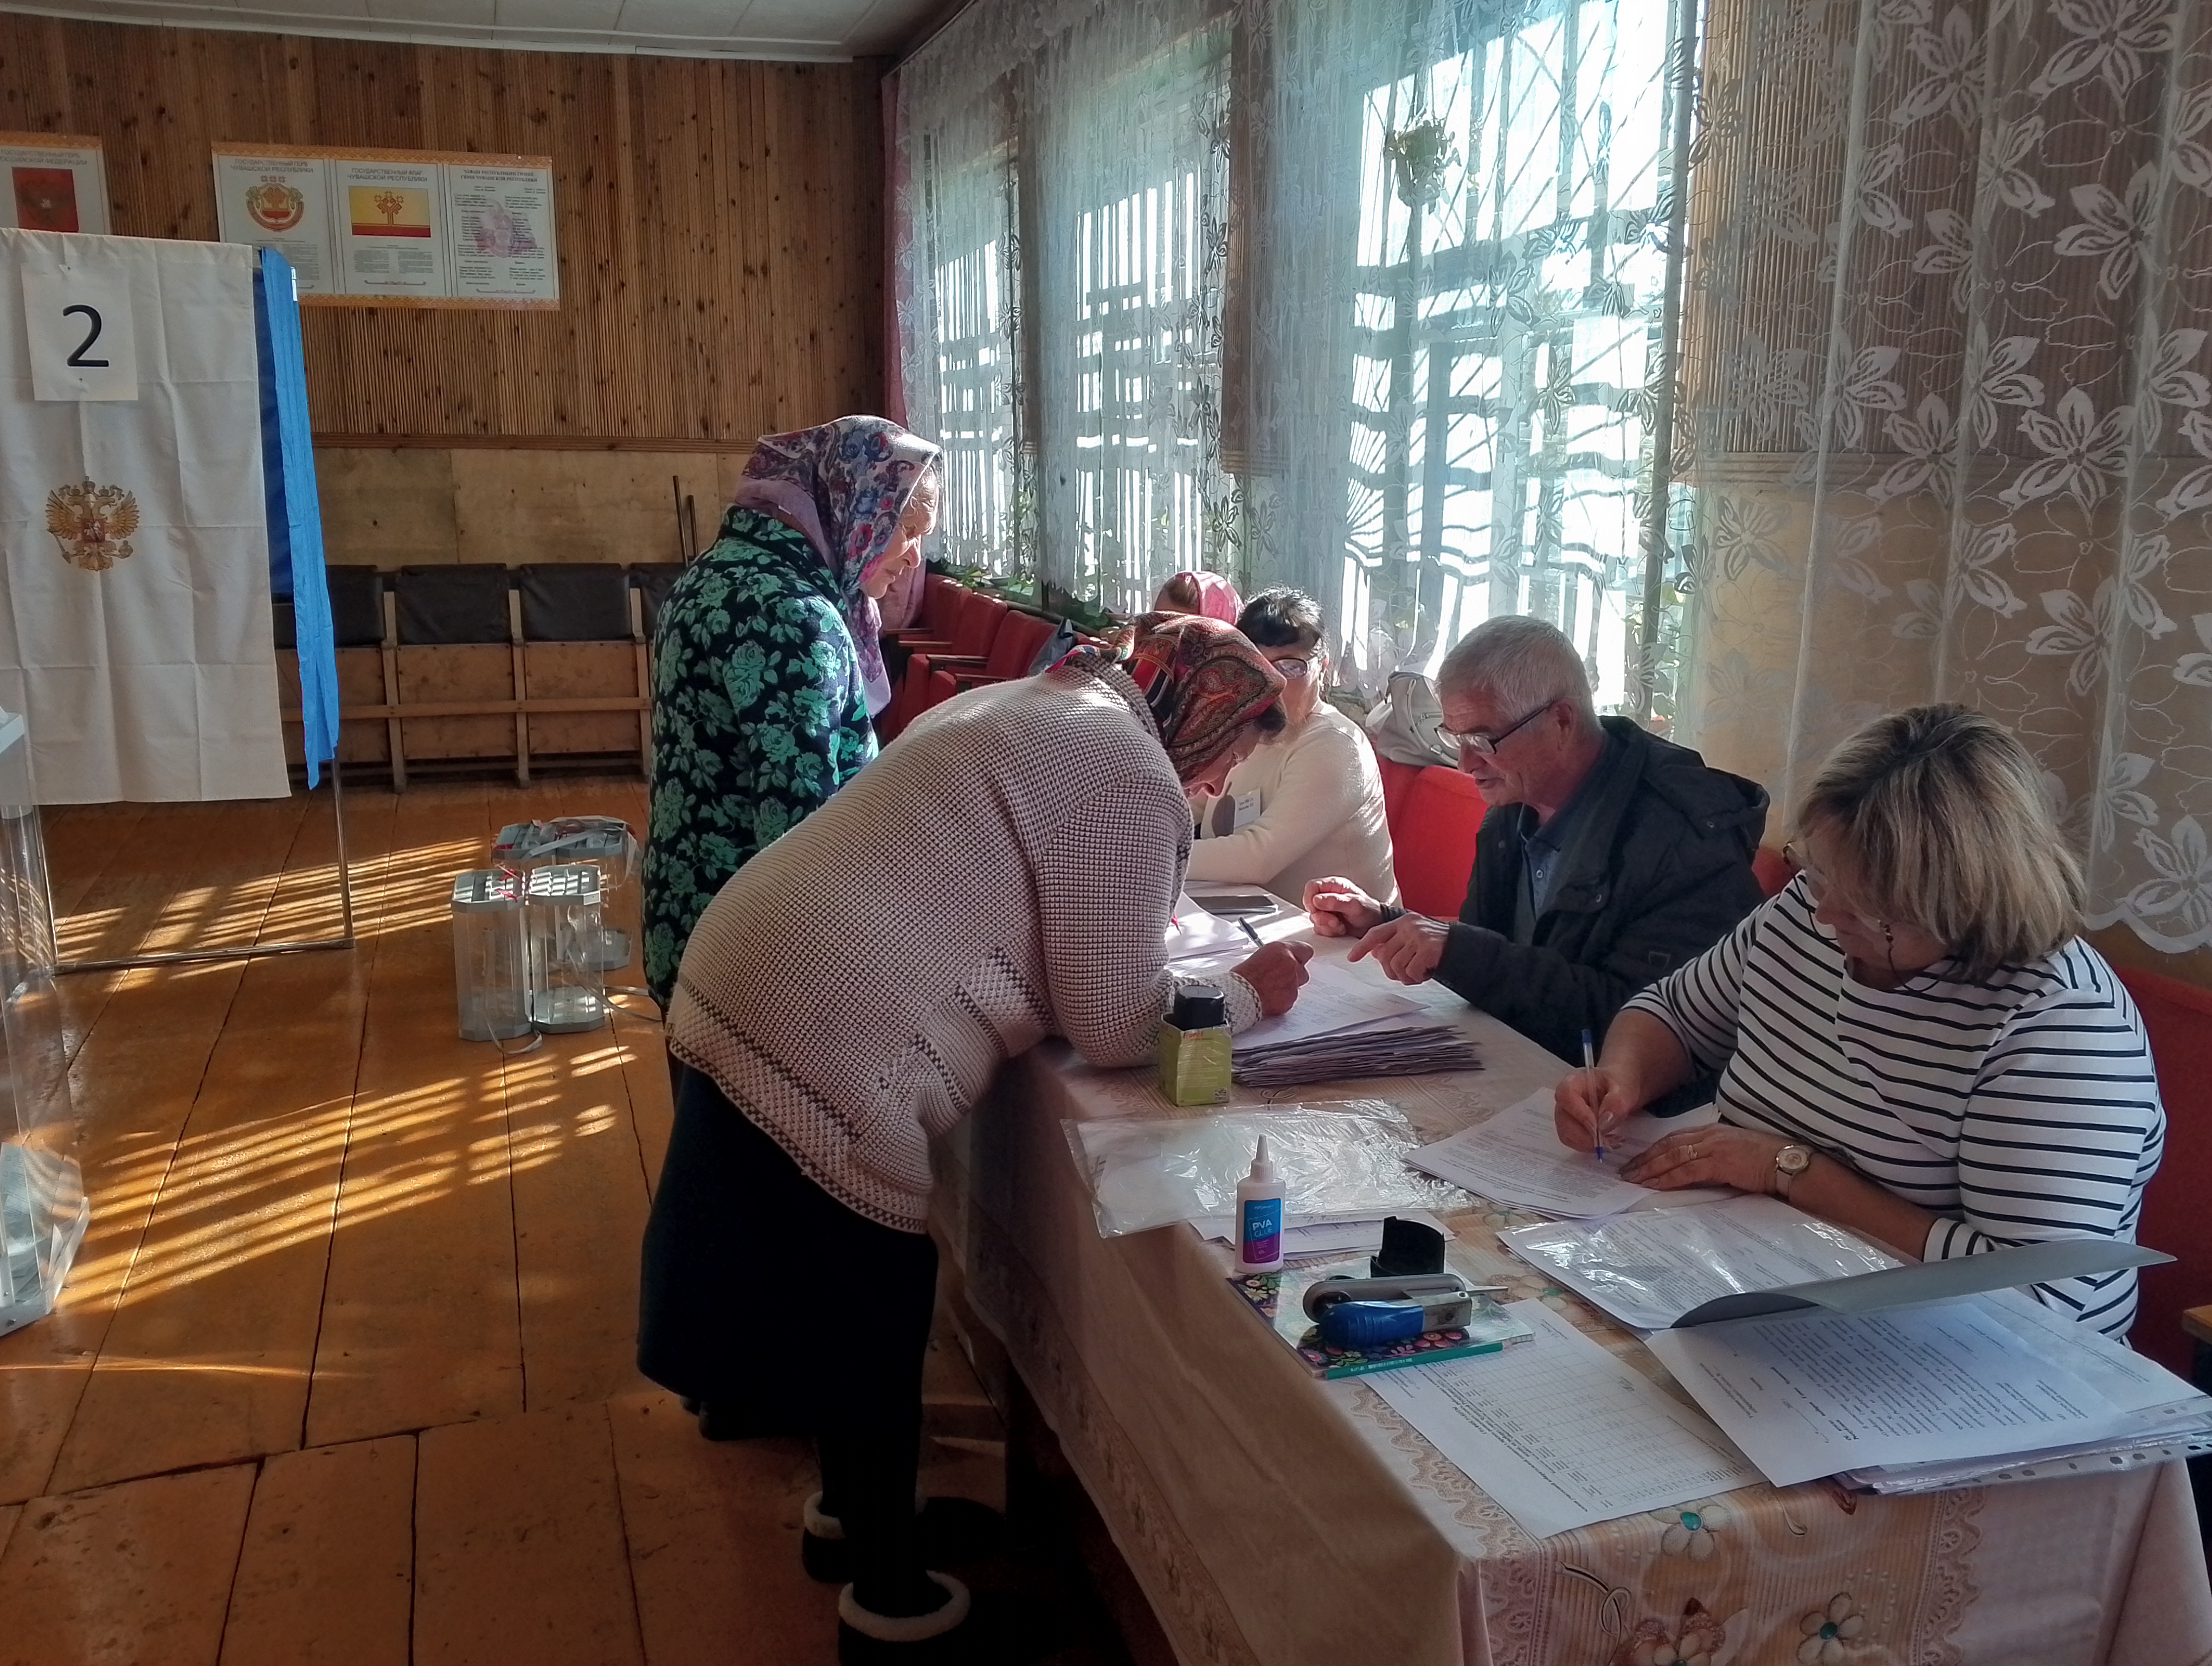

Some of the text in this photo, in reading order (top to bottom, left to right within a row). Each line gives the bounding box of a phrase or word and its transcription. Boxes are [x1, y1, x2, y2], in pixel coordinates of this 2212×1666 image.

[62, 304, 110, 367] 2
[1252, 1219, 1272, 1231] PVA
[1254, 1227, 1273, 1237] GLUE
